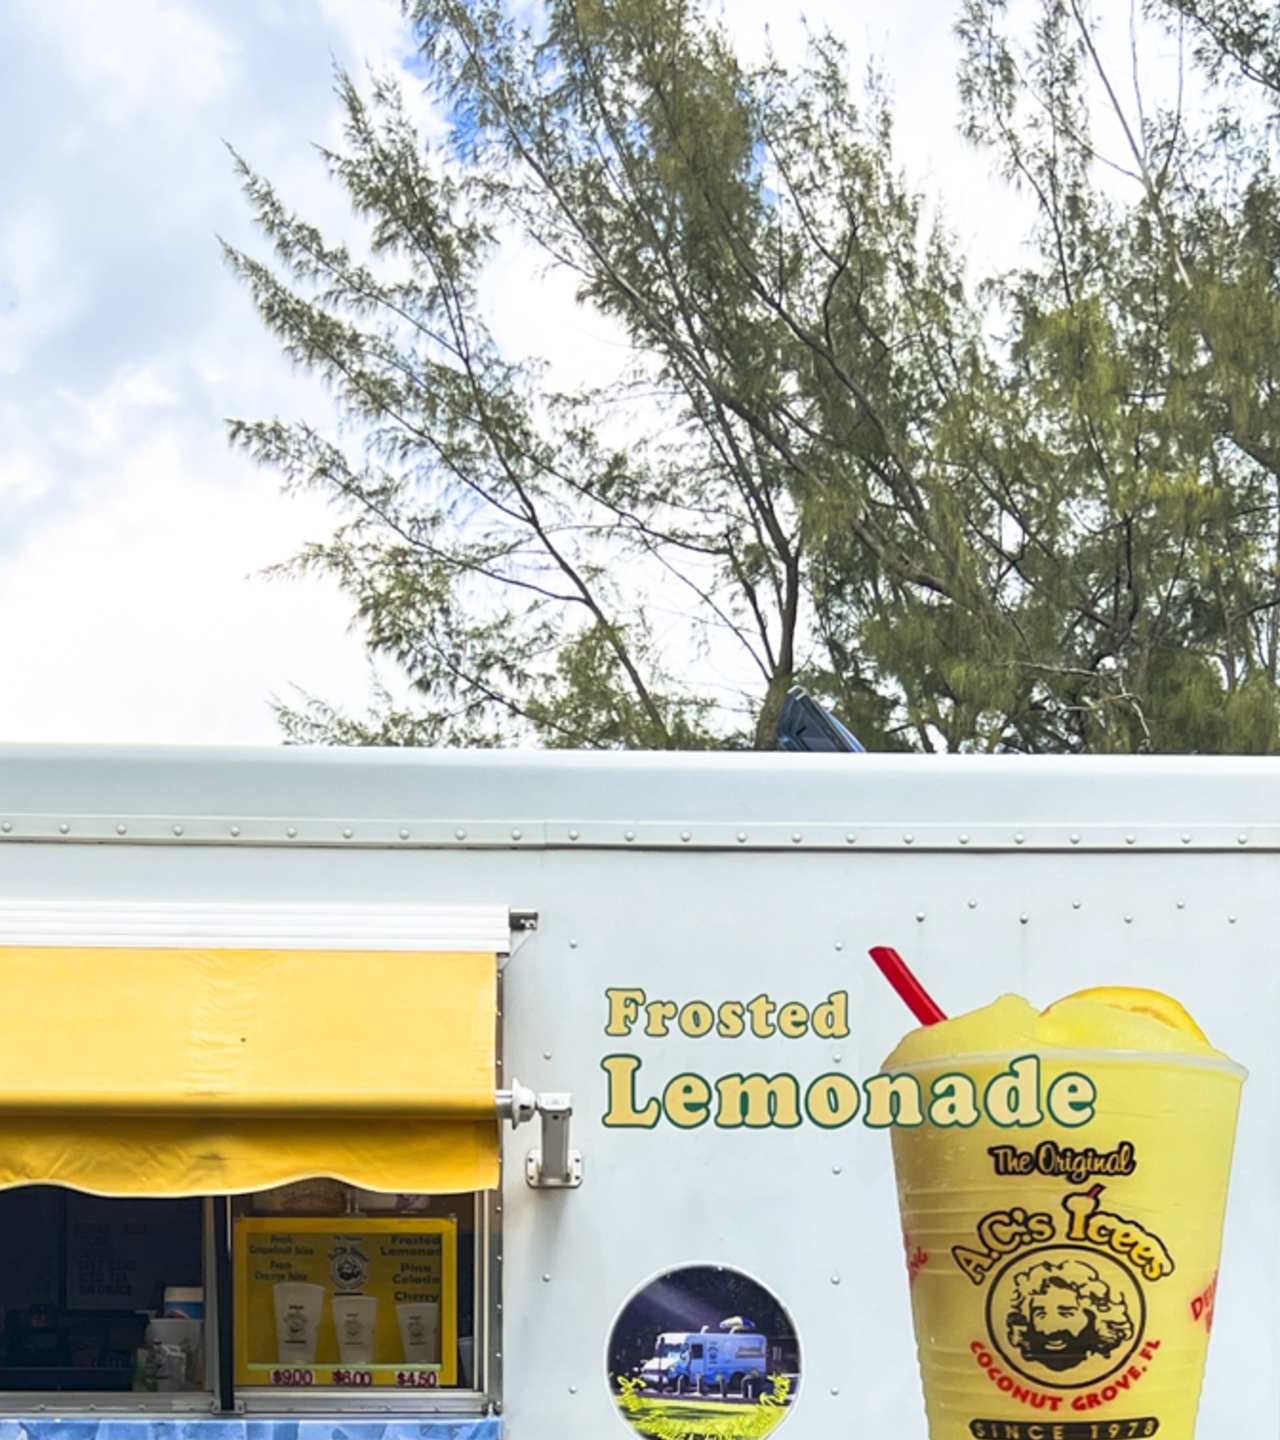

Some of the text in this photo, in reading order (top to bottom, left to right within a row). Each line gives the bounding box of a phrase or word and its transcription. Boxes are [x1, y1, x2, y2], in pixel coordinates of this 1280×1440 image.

[604, 988, 851, 1038] Frosted
[601, 1054, 1097, 1129] Lemonade
[988, 1141, 1136, 1184] The Original
[1062, 1183, 1175, 1281] Icees
[970, 1341, 1064, 1411] COCONUT
[1138, 1340, 1161, 1360] FL
[974, 1420, 1153, 1440] SINCE 1978
